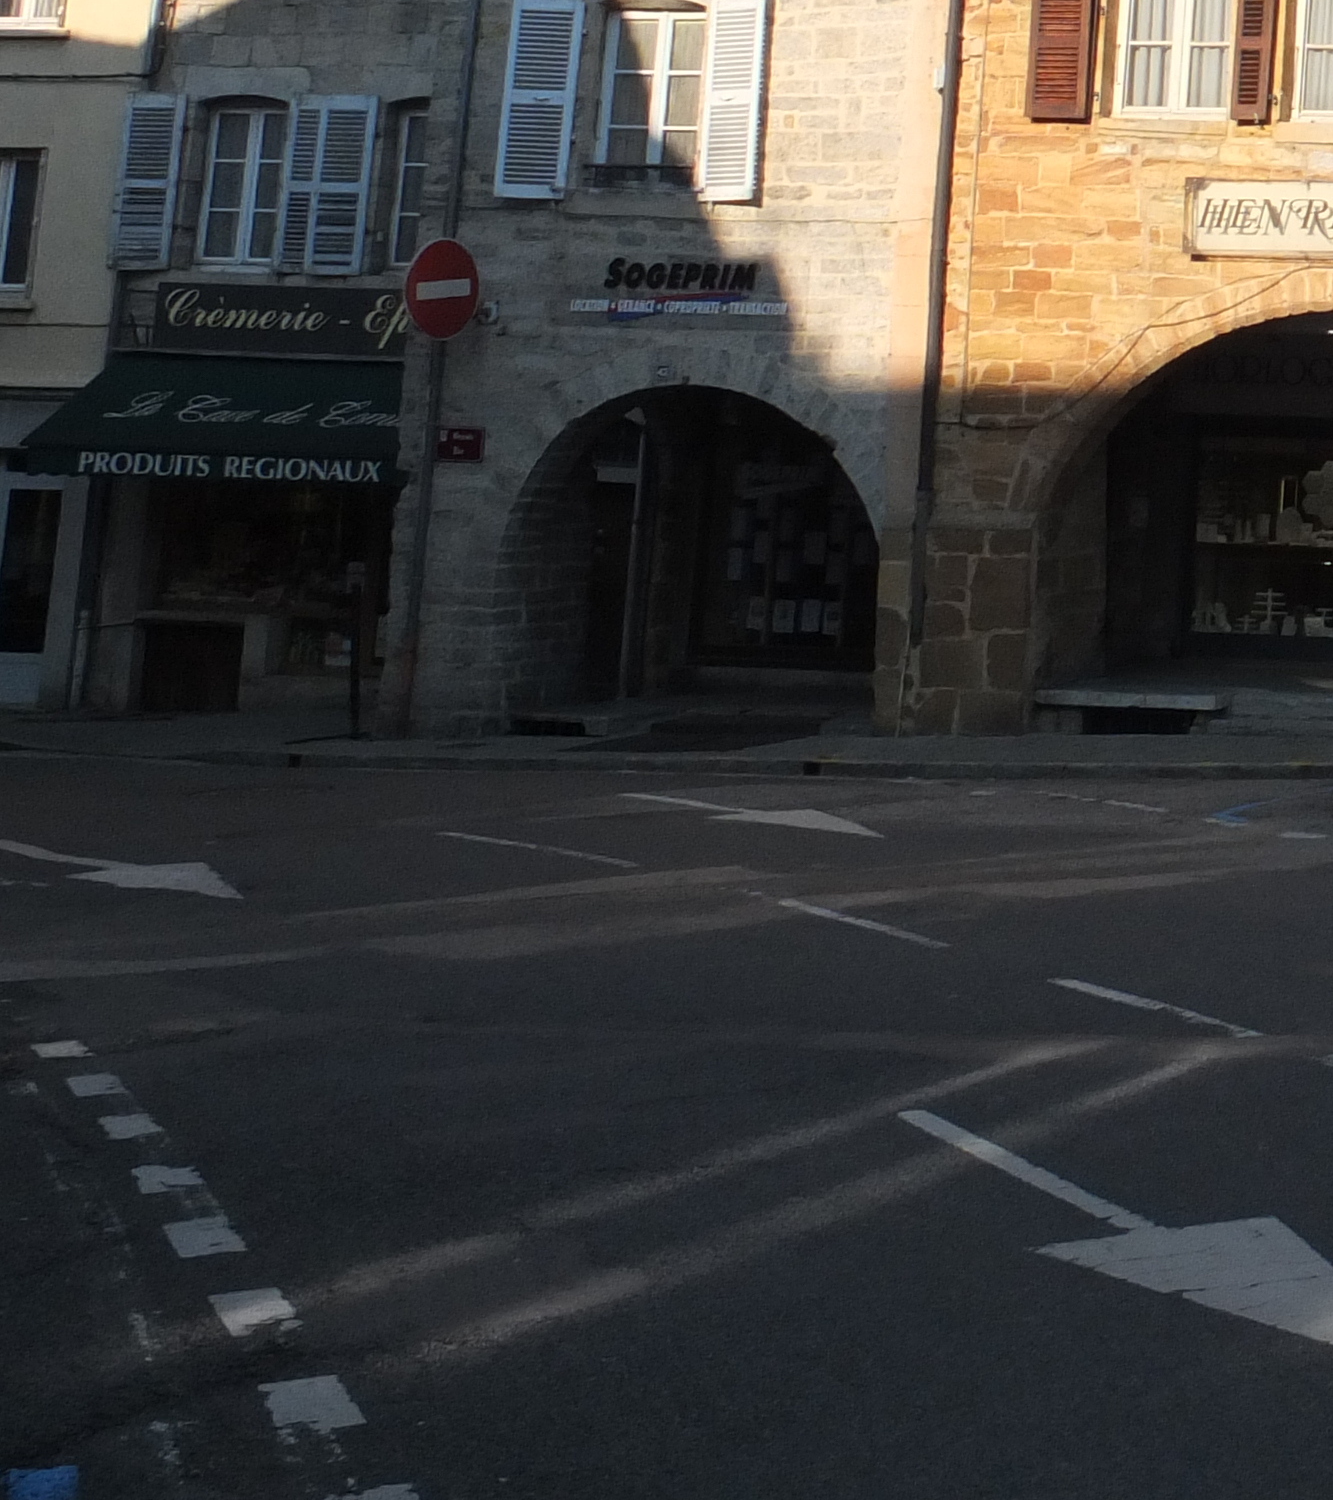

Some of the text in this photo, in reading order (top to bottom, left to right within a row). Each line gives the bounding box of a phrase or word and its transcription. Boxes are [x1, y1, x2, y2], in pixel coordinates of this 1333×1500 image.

[604, 257, 758, 291] SOGEPRIM
[165, 288, 332, 331] Crèmerie
[78, 452, 381, 482] PRODUITS REGIONAUX
